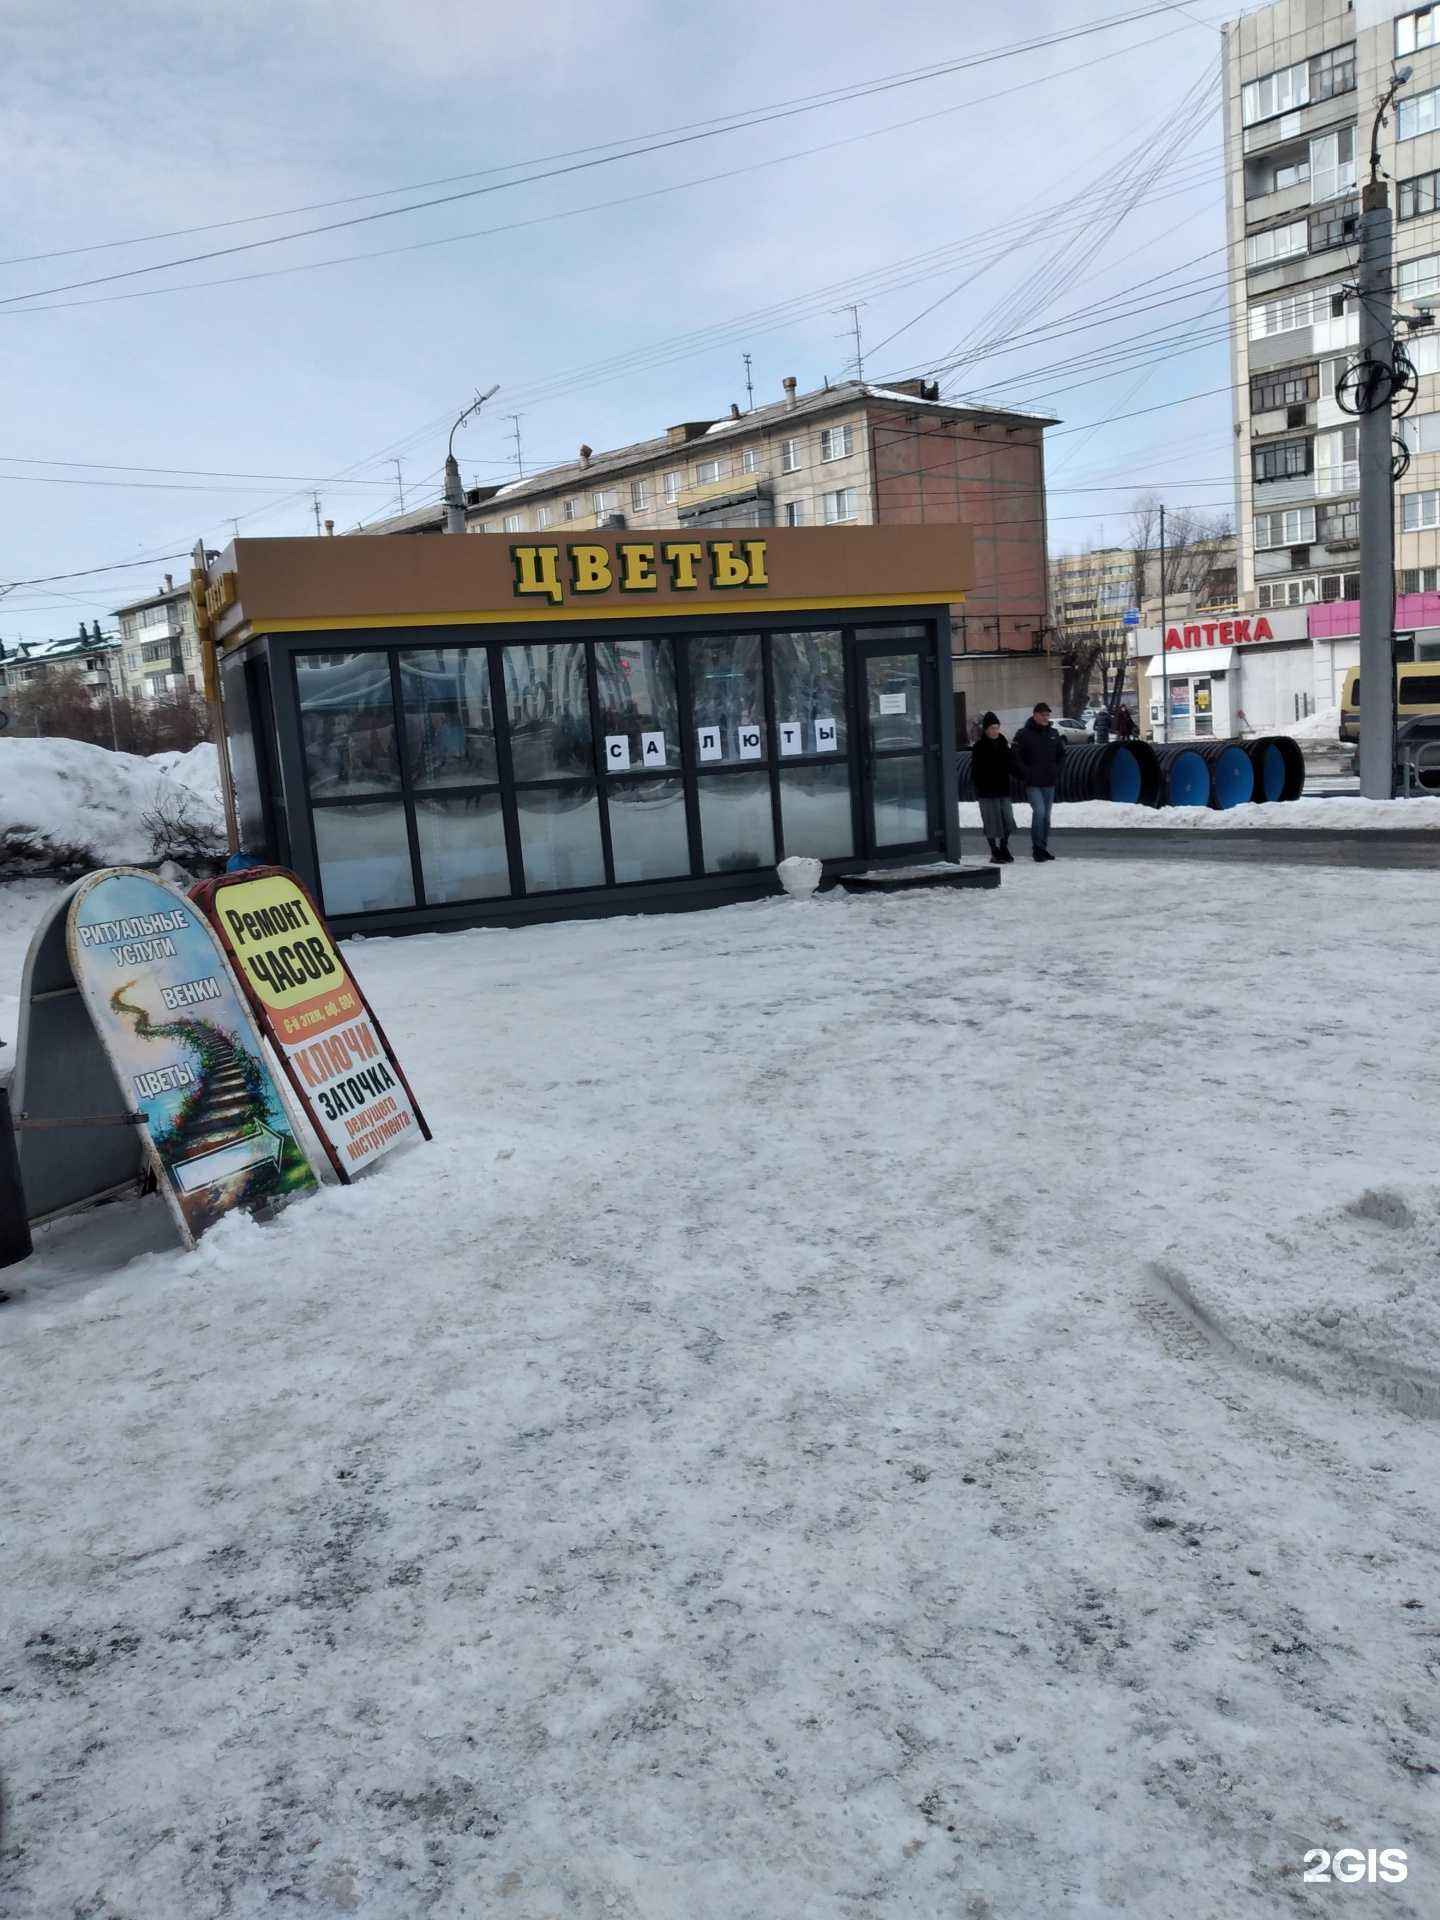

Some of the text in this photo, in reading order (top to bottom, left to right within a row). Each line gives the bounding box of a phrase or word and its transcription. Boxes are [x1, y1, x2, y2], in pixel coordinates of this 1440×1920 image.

[511, 540, 769, 606] ЦВЕТЫ
[1164, 616, 1274, 651] АПТЕКА
[79, 910, 189, 947] РИТУАЛЬНЫЕ
[112, 937, 177, 967] УСЛУГИ
[247, 936, 336, 993] ЧАСОВ
[160, 976, 222, 1010] ВЕНКИ
[293, 1022, 379, 1088] КЛЮЧИ
[133, 1062, 195, 1100] ЦВЕТЫ
[318, 1062, 396, 1121] ЗАТОЧКА
[344, 1096, 397, 1140] режущего
[346, 1110, 411, 1160] инструмента
